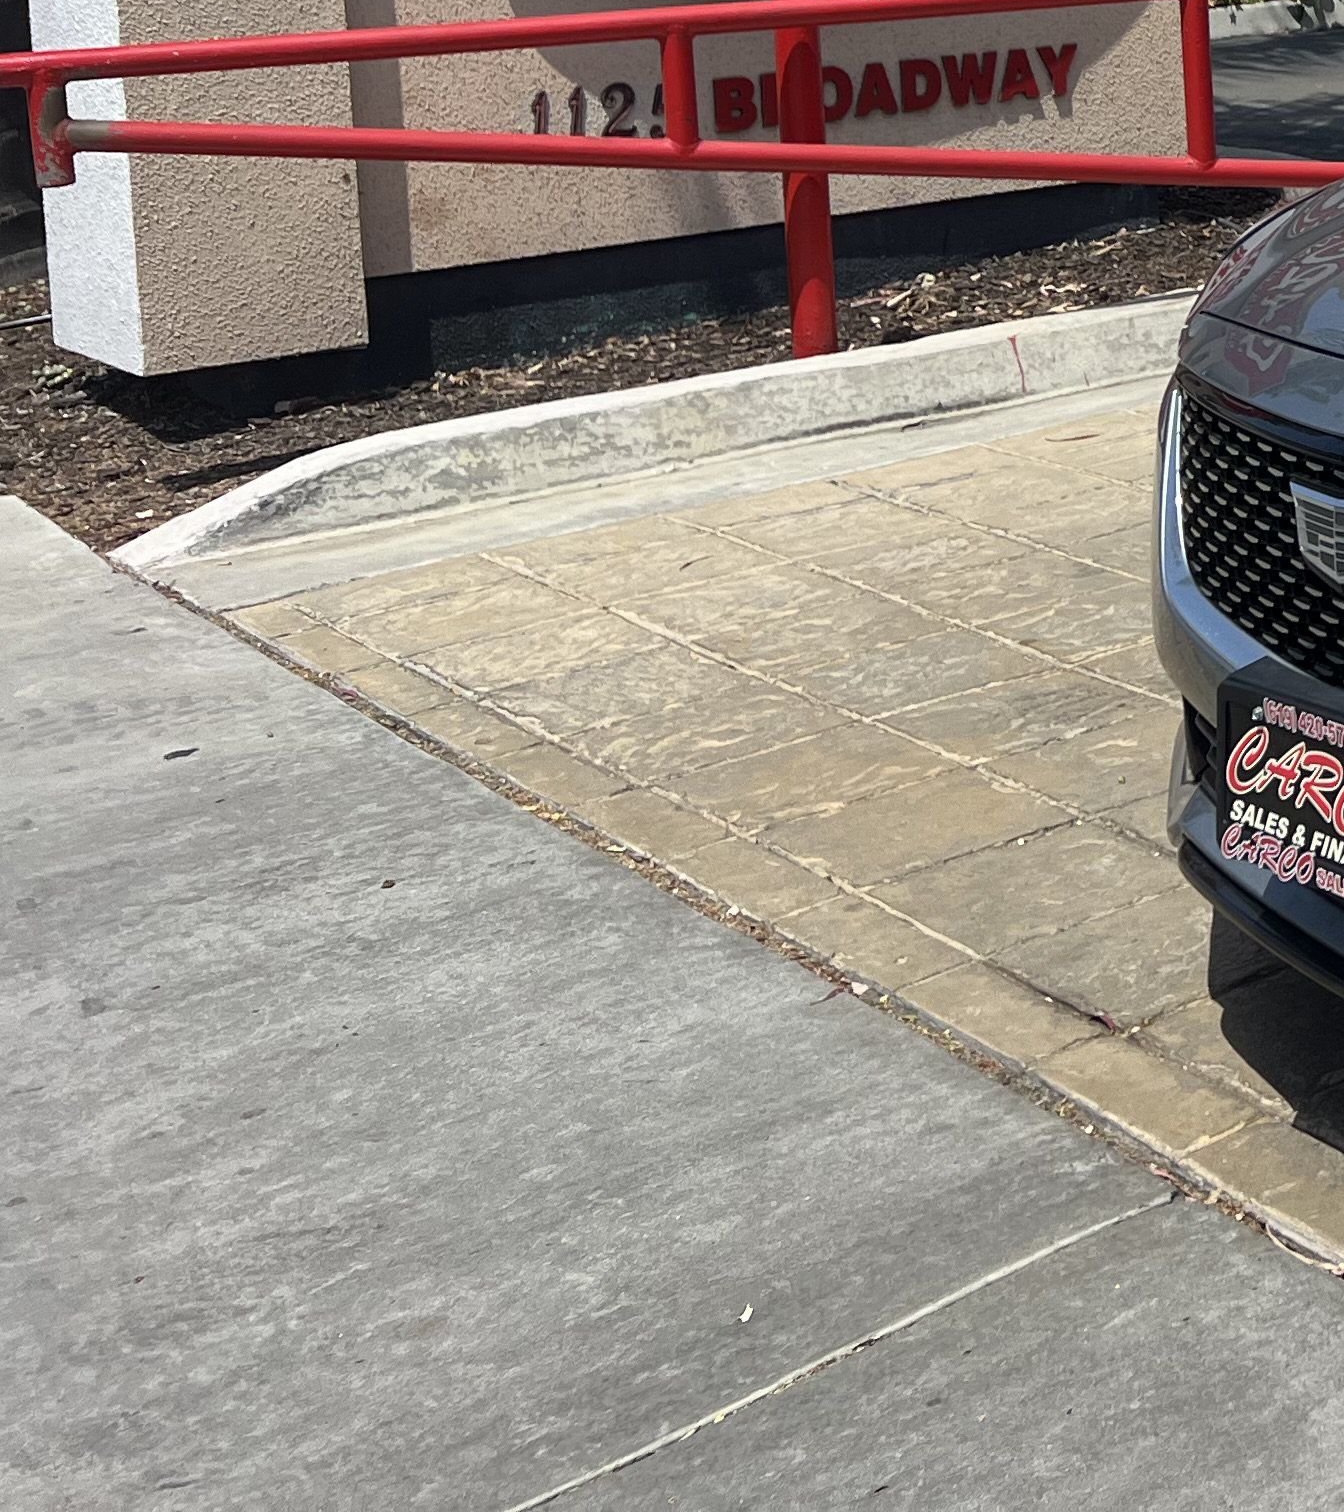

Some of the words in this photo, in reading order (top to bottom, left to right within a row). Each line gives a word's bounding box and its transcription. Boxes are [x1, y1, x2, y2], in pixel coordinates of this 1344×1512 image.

[712, 42, 1078, 133] BOADWAY
[1262, 696, 1298, 734] (619)
[1230, 799, 1290, 840] SALES
[1293, 824, 1307, 849] &
